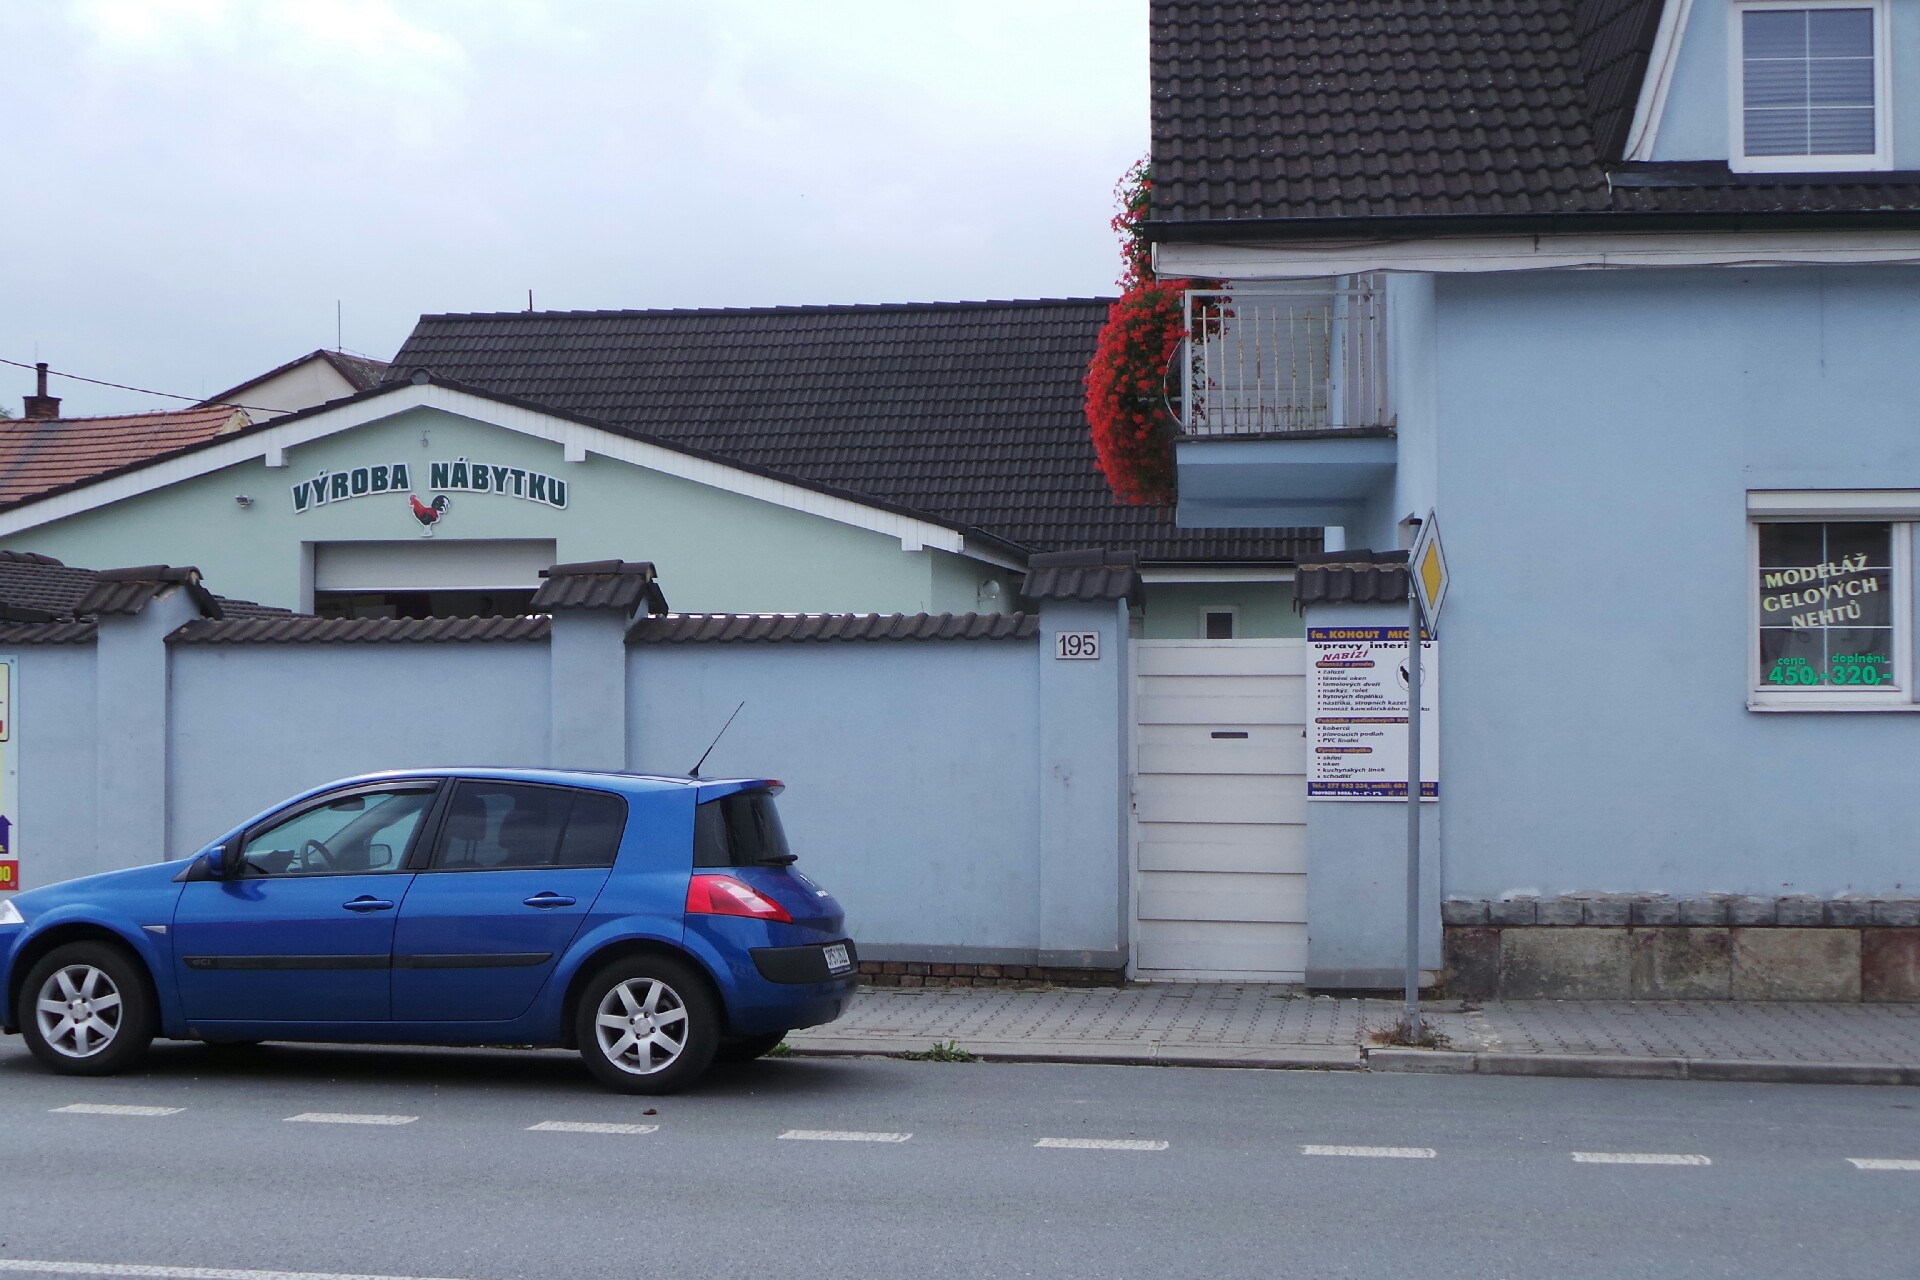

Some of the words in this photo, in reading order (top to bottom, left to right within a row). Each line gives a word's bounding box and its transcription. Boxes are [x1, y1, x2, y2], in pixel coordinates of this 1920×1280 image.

[291, 463, 411, 513] VÝROBA
[429, 456, 568, 510] NÁBYTKU
[1765, 553, 1868, 588] MODELÁŽ
[1763, 577, 1878, 612] GELOVÝCH
[1791, 599, 1861, 629] NEHTŮ
[1059, 634, 1096, 656] 195
[1329, 630, 1380, 639] KOHOUT
[1777, 657, 1806, 665] cena
[1832, 652, 1886, 664] doplnění
